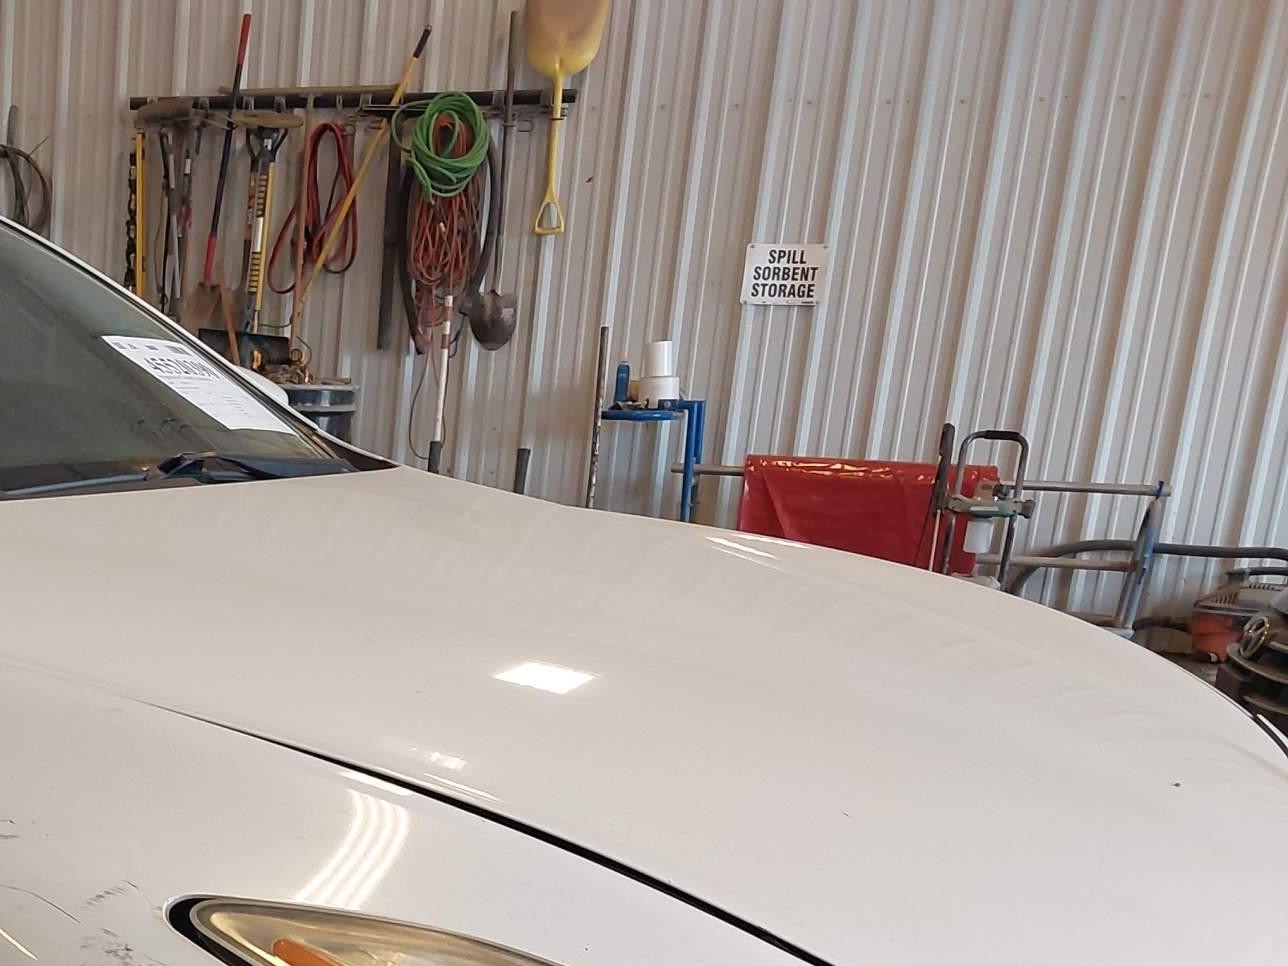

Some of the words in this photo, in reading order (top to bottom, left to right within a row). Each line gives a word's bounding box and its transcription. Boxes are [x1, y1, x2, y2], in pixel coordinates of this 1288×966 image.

[768, 249, 807, 265] SPILL
[753, 266, 819, 281] SORBENT
[751, 283, 815, 298] STORAGE
